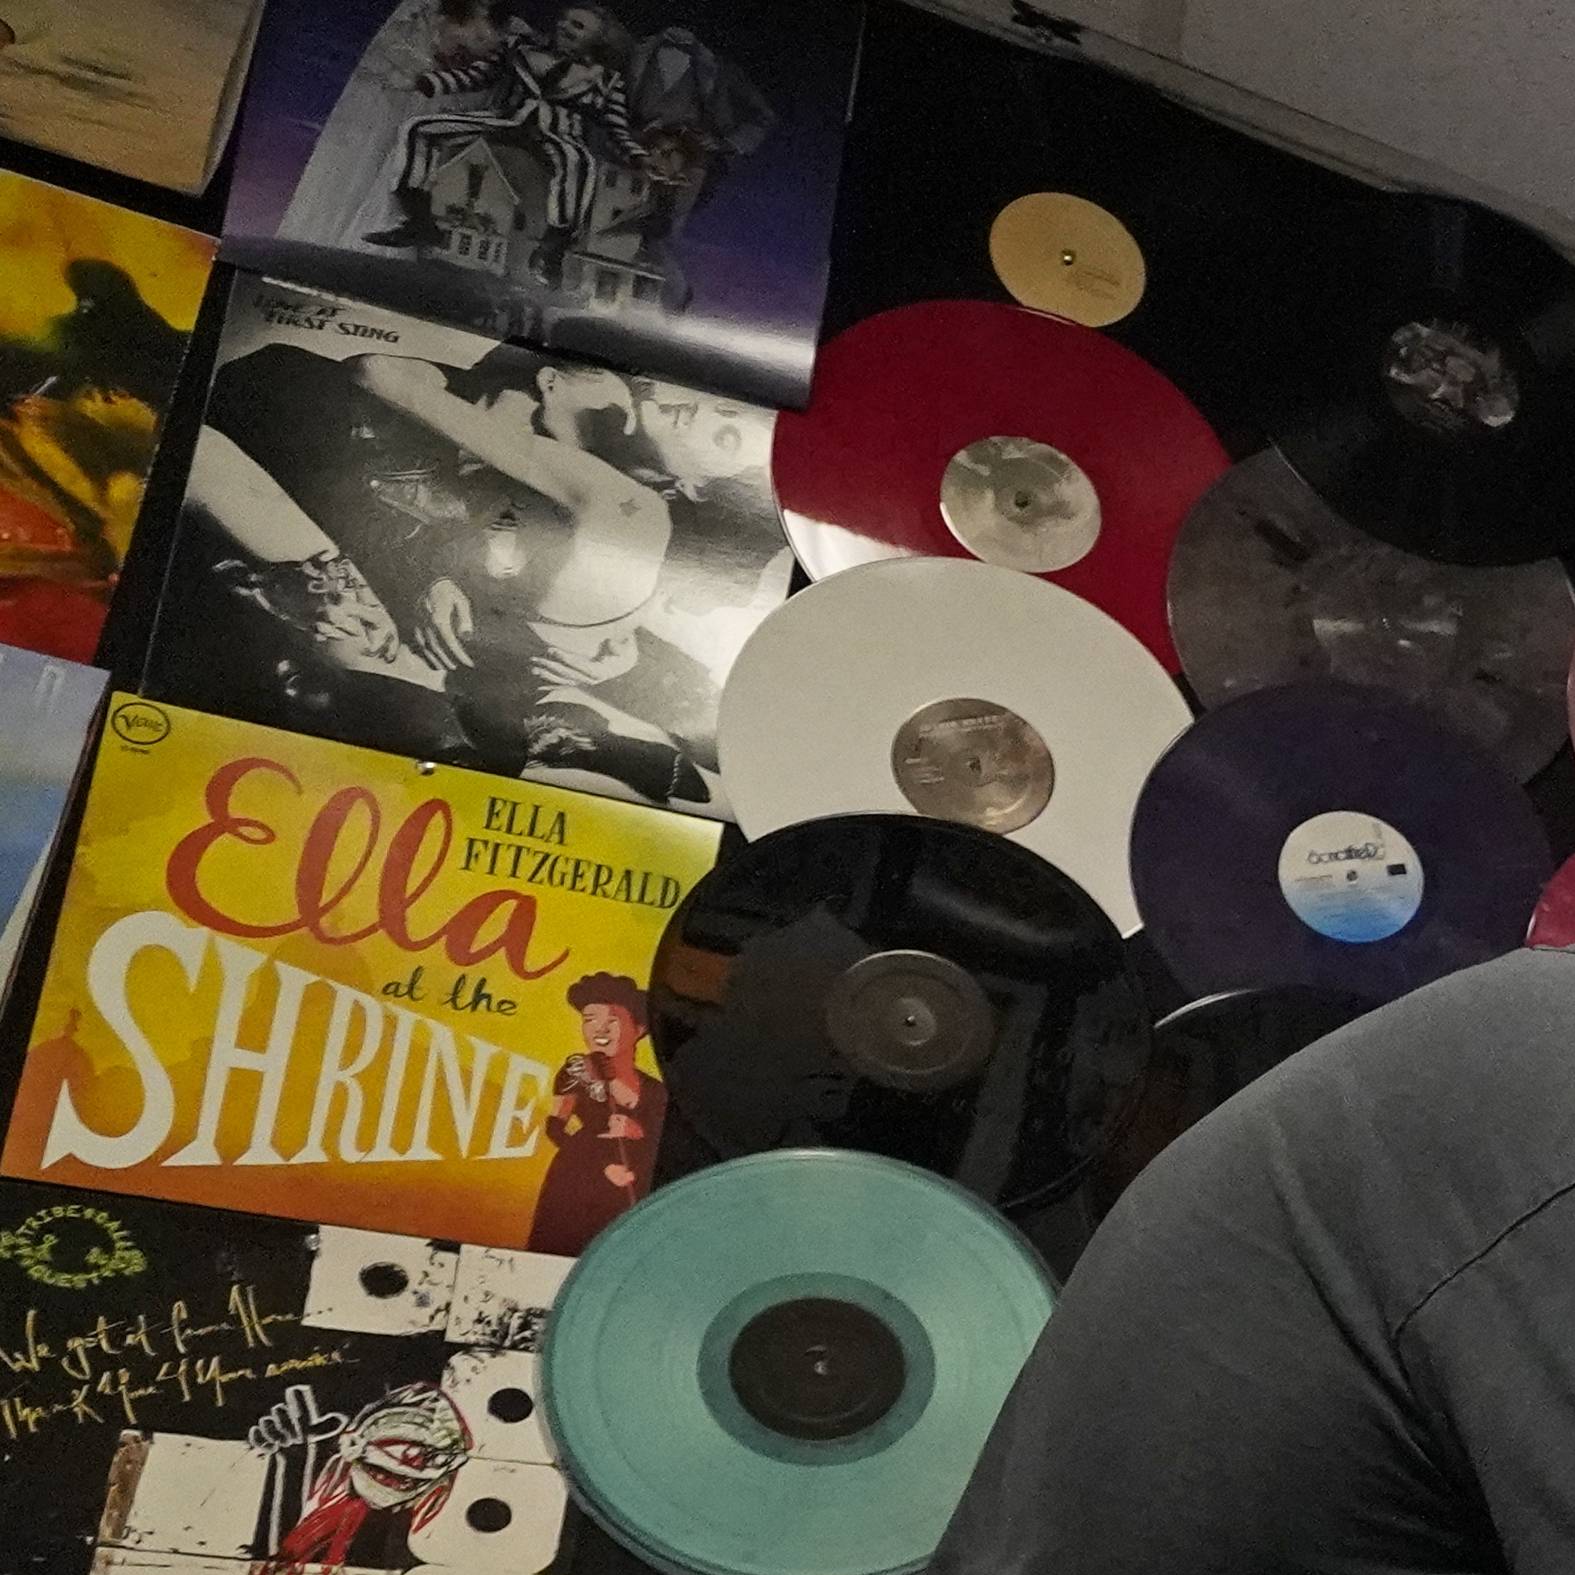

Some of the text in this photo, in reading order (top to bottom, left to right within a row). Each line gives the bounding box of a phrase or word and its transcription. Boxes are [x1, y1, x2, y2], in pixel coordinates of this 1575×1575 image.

[336, 321, 400, 344] STING
[483, 797, 570, 847] ELLA
[166, 757, 571, 981] Ella
[458, 836, 683, 911] FITZGERALD
[381, 965, 519, 1019] at the
[41, 911, 552, 1170] SHRINE
